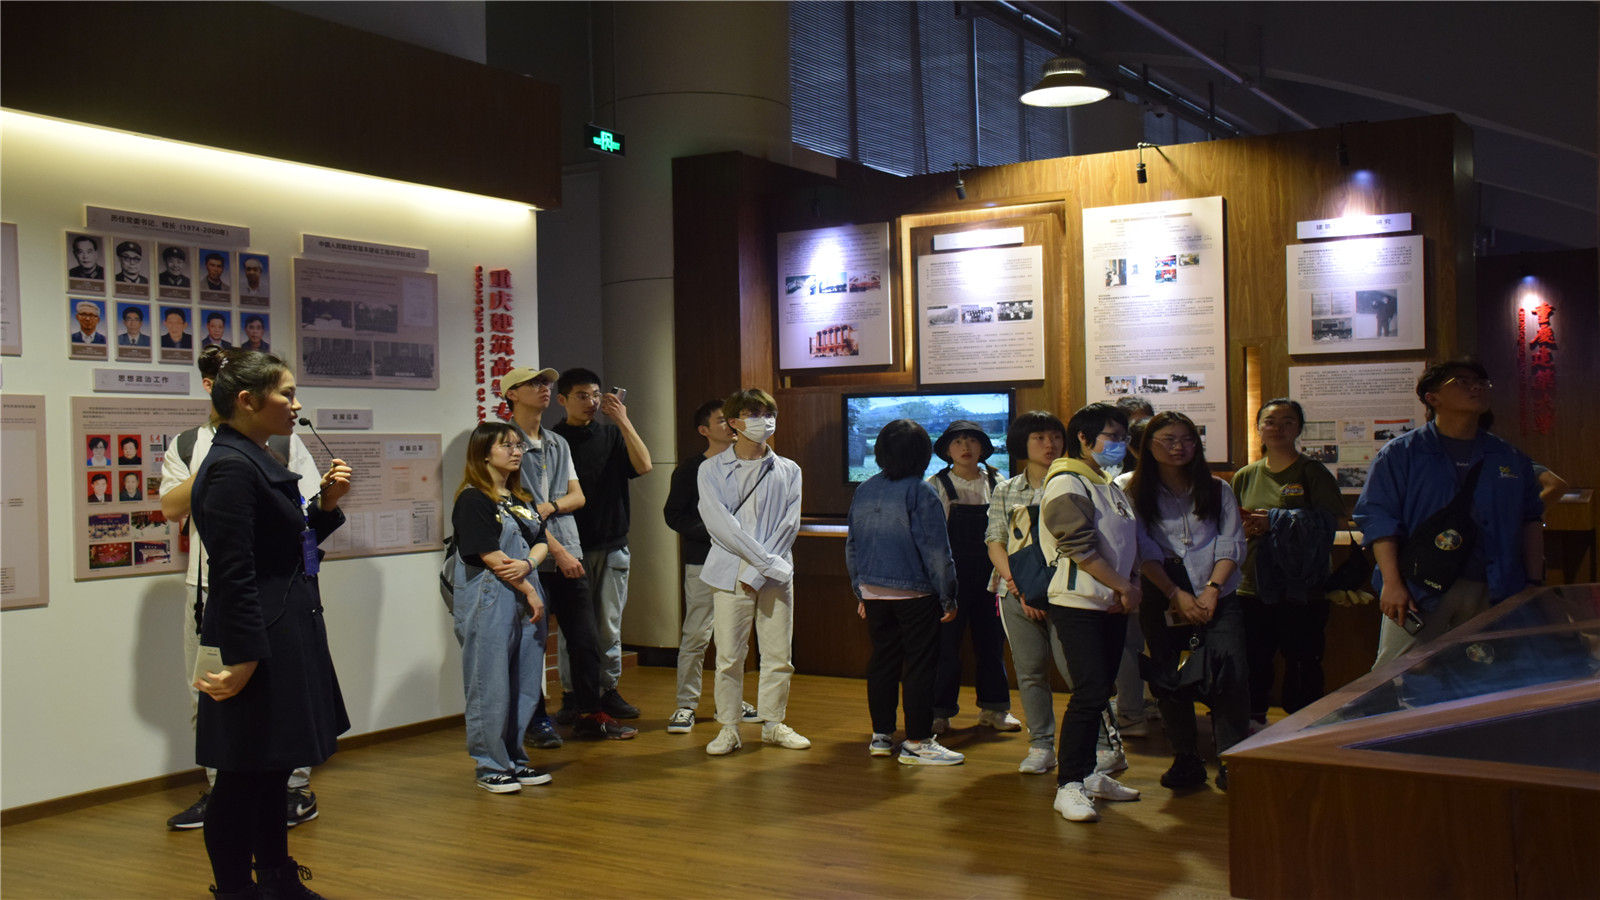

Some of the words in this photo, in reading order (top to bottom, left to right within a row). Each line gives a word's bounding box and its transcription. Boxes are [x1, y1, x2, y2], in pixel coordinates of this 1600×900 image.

[474, 265, 484, 334] CHONGQING
[475, 336, 486, 384] COLLEGE
[118, 374, 168, 384] 思想政治工作
[477, 387, 486, 401] OF
[1423, 579, 1442, 591] NASA
